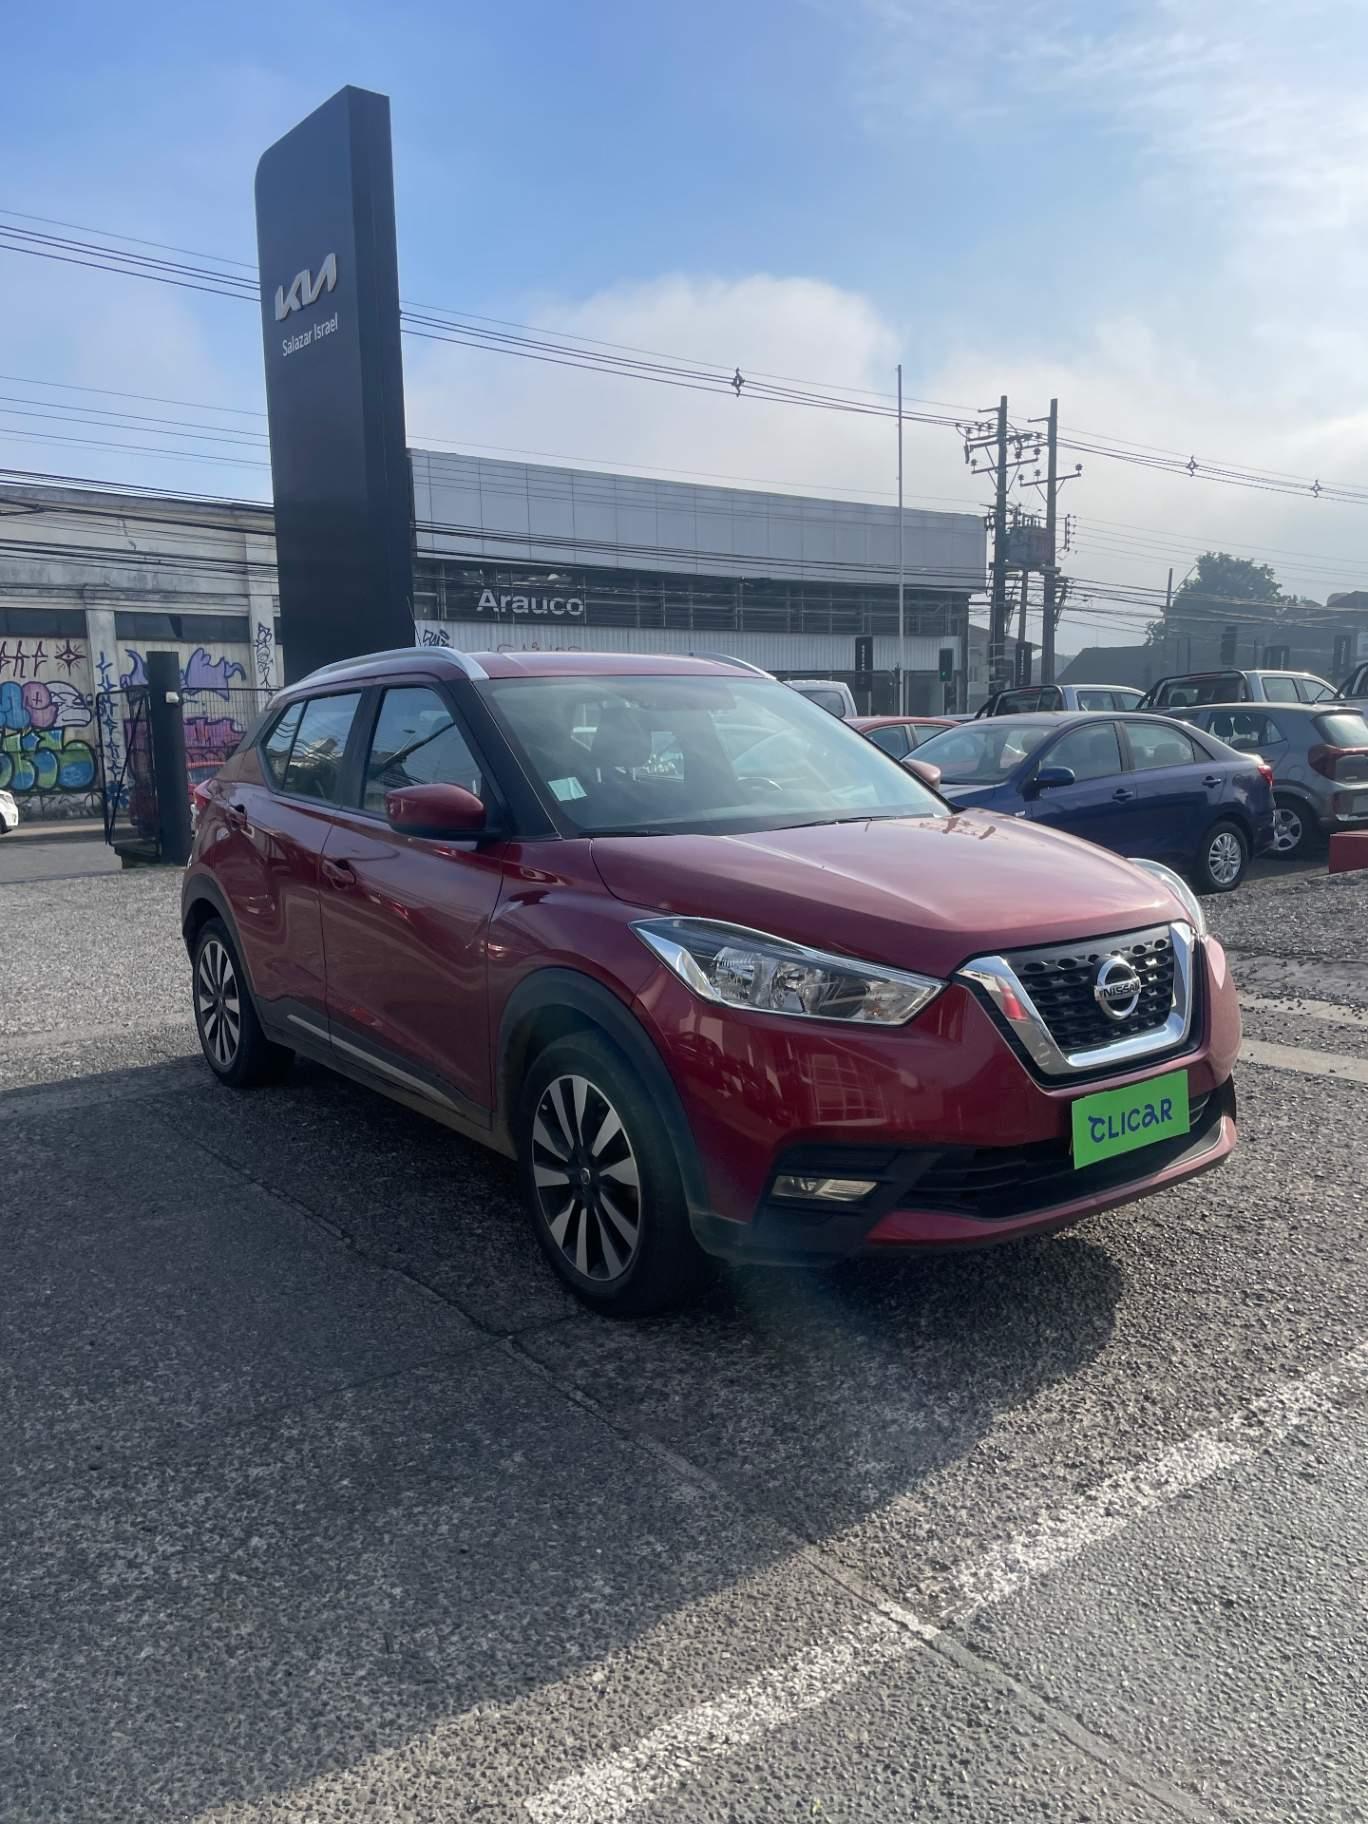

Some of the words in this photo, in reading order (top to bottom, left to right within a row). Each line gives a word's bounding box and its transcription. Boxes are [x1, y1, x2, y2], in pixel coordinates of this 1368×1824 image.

[282, 331, 313, 357] Salazar
[314, 312, 338, 341] Israel
[477, 588, 584, 615] Arauco
[1102, 982, 1140, 998] NISSAN
